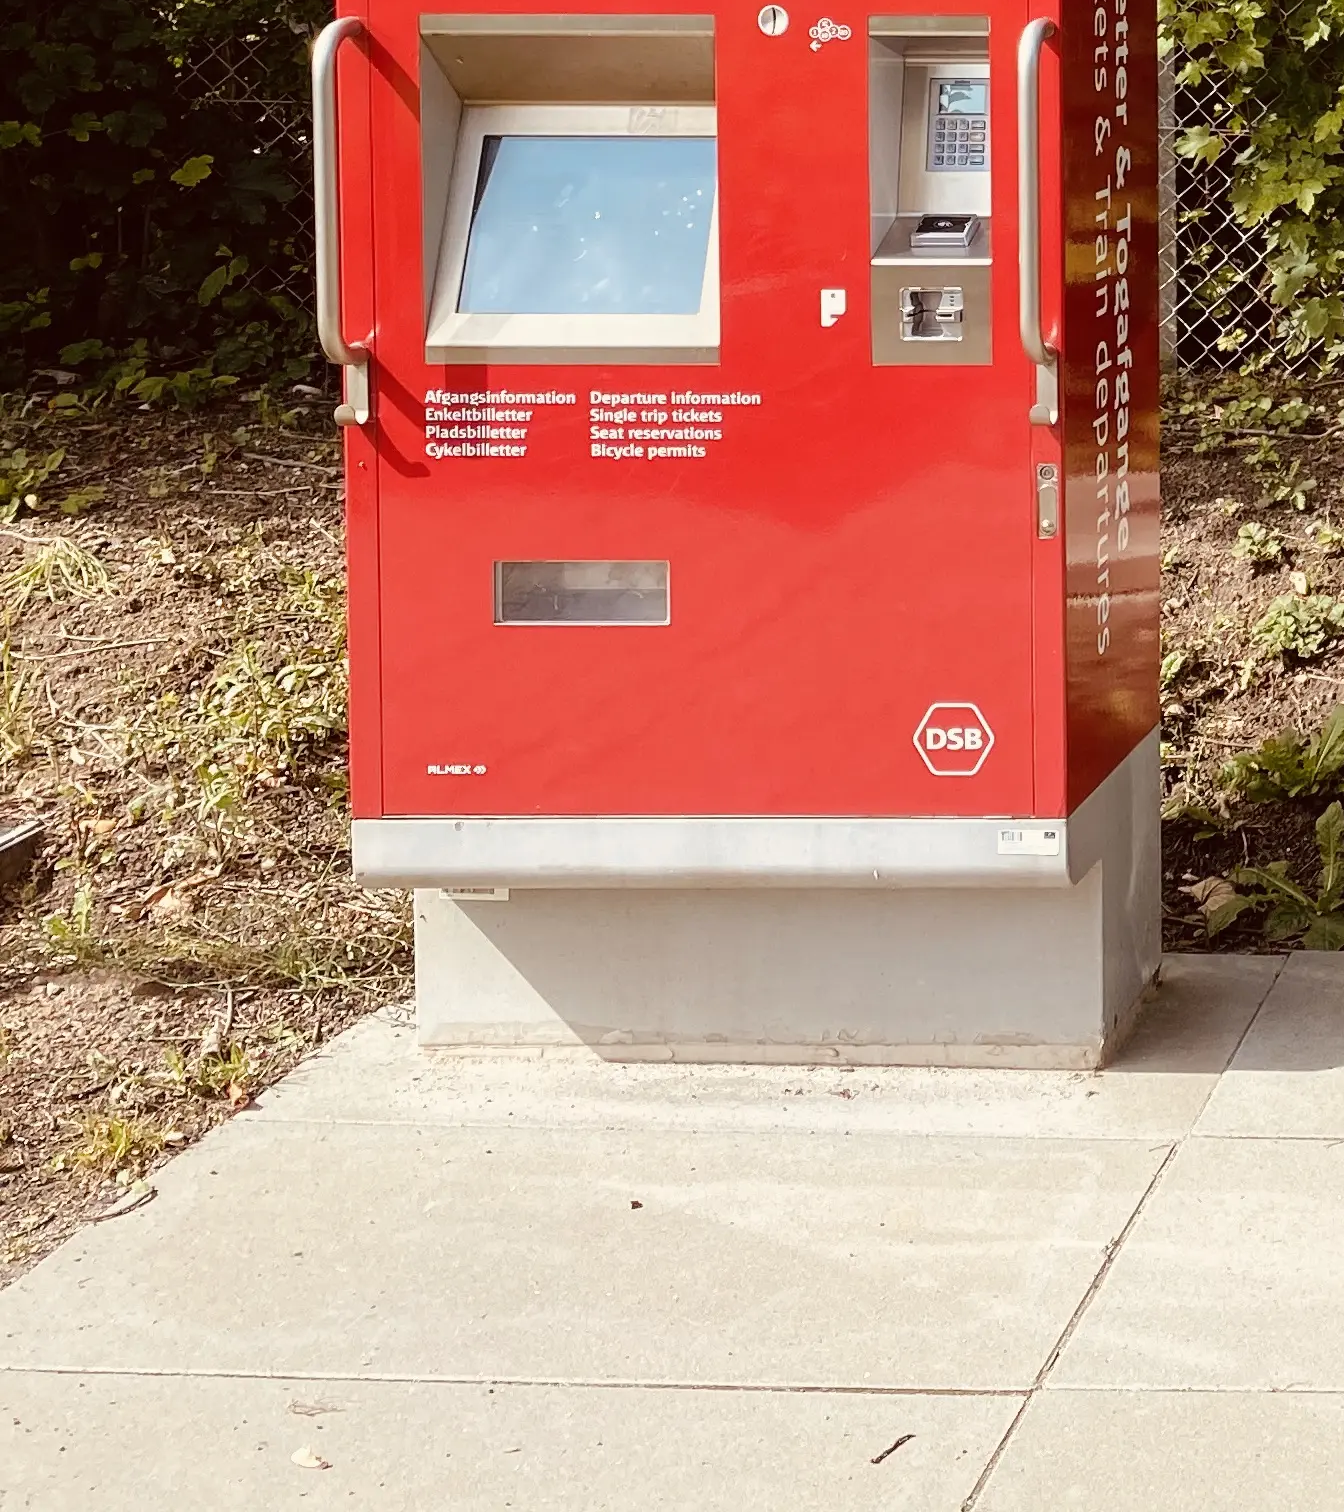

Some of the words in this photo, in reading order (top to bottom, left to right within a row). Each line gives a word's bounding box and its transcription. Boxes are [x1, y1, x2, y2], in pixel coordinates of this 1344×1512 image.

[1095, 116, 1110, 155] &
[1116, 146, 1130, 189] &
[1096, 175, 1111, 317] Train
[1113, 203, 1132, 552] Togafgange
[425, 390, 575, 406] Afgangsinformation
[590, 391, 666, 407] Departure
[671, 391, 760, 404] information
[426, 408, 532, 421] Enkeltbilletter
[590, 408, 637, 424] Single
[641, 409, 668, 424] trip
[672, 409, 722, 422] tickets
[426, 425, 527, 439] Pladsbilletter
[591, 426, 624, 439] Seat
[628, 427, 722, 439] reservations
[426, 443, 527, 459] Cykelbilletter
[591, 444, 642, 459] Bicycle
[648, 444, 706, 459] permits
[1092, 341, 1113, 655] departures
[927, 728, 982, 750] DSB
